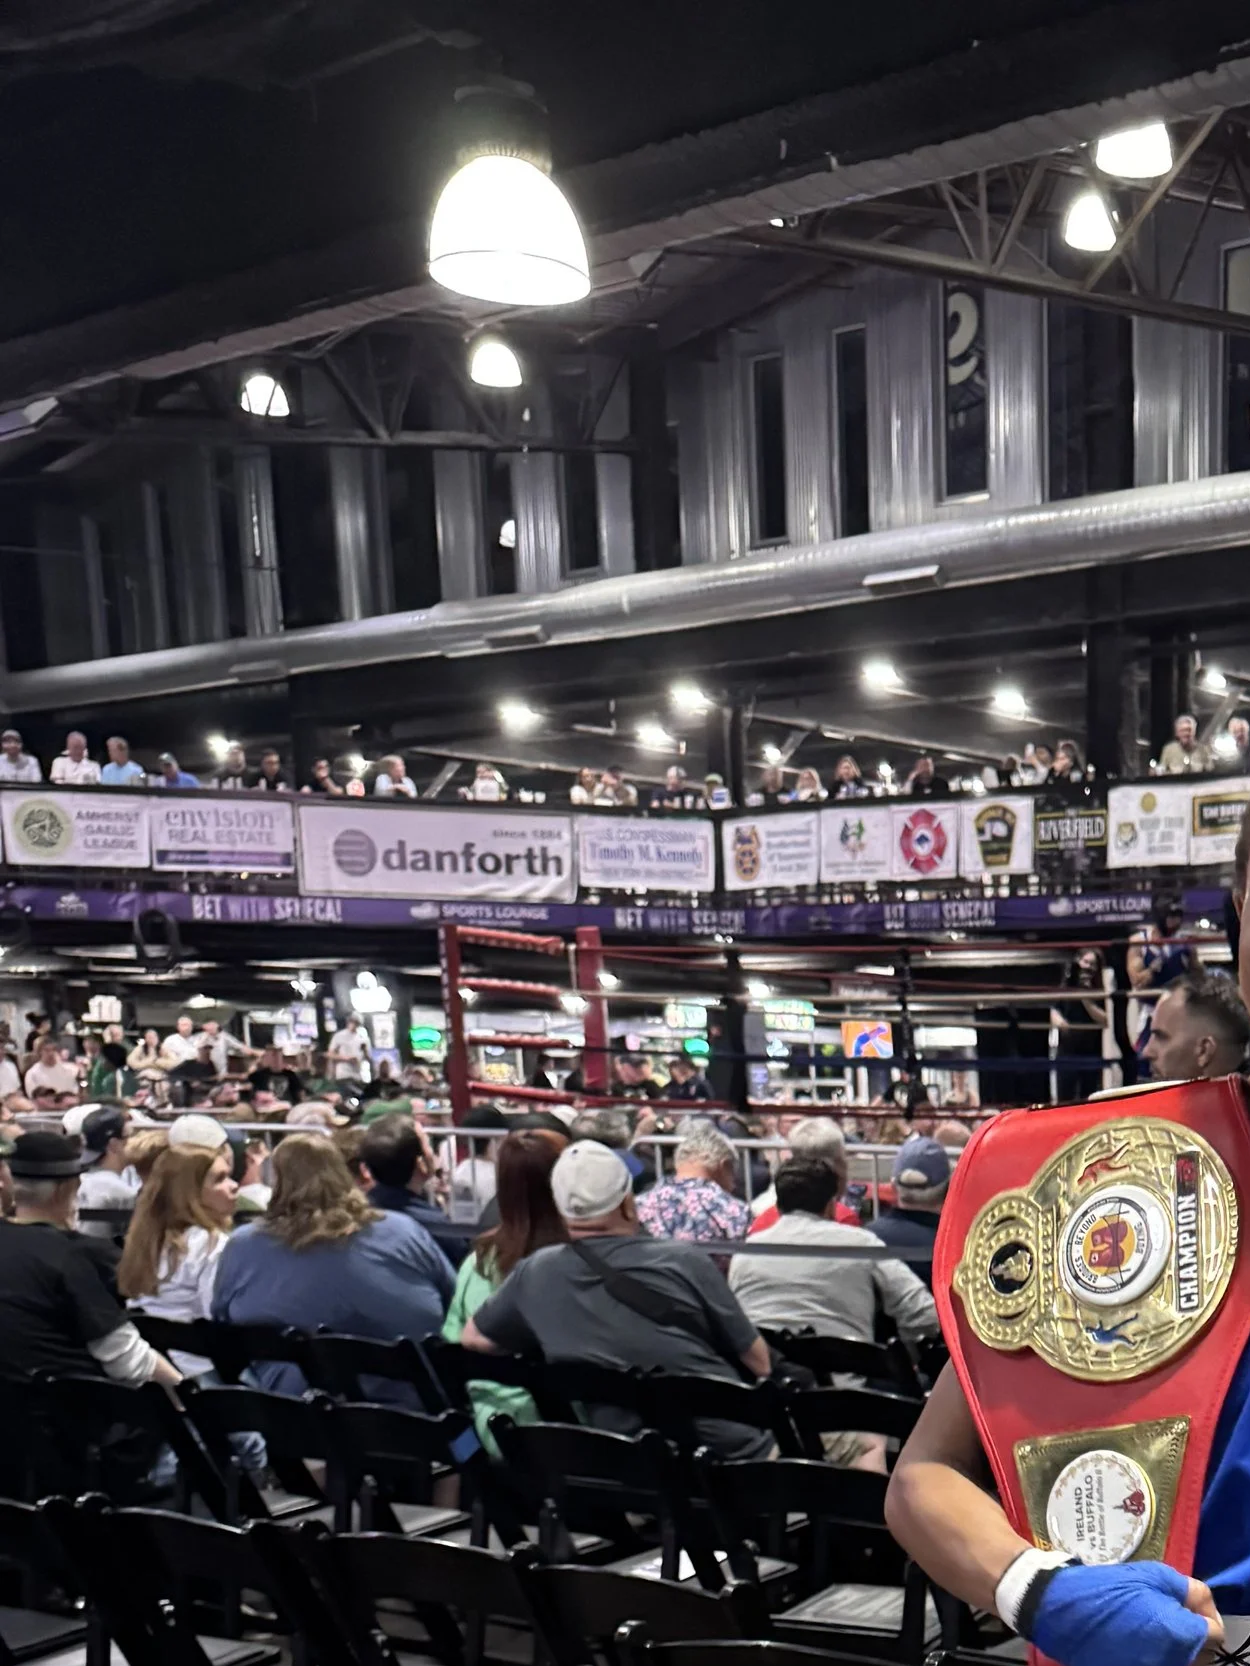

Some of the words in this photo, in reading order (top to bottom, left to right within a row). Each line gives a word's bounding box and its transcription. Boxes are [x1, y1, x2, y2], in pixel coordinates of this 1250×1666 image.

[75, 810, 141, 824] AMHERST
[164, 807, 276, 830] envision
[83, 824, 136, 837] GAELIC
[168, 829, 209, 844] REAL
[214, 829, 277, 846] ESTATE
[83, 837, 138, 851] LEAGUE
[588, 841, 635, 863] Timothy
[382, 839, 564, 877] danforth
[192, 895, 222, 920] BET
[226, 897, 271, 921] WITH
[442, 902, 492, 918] SPORTS
[496, 904, 550, 921] LOUNGE
[1120, 896, 1152, 912] LOUN
[1074, 1213, 1098, 1246] BEYOND
[1176, 1192, 1200, 1309] CHAMPION
[1074, 1486, 1085, 1542] IRELAND
[1084, 1474, 1097, 1534] BUFFALO
